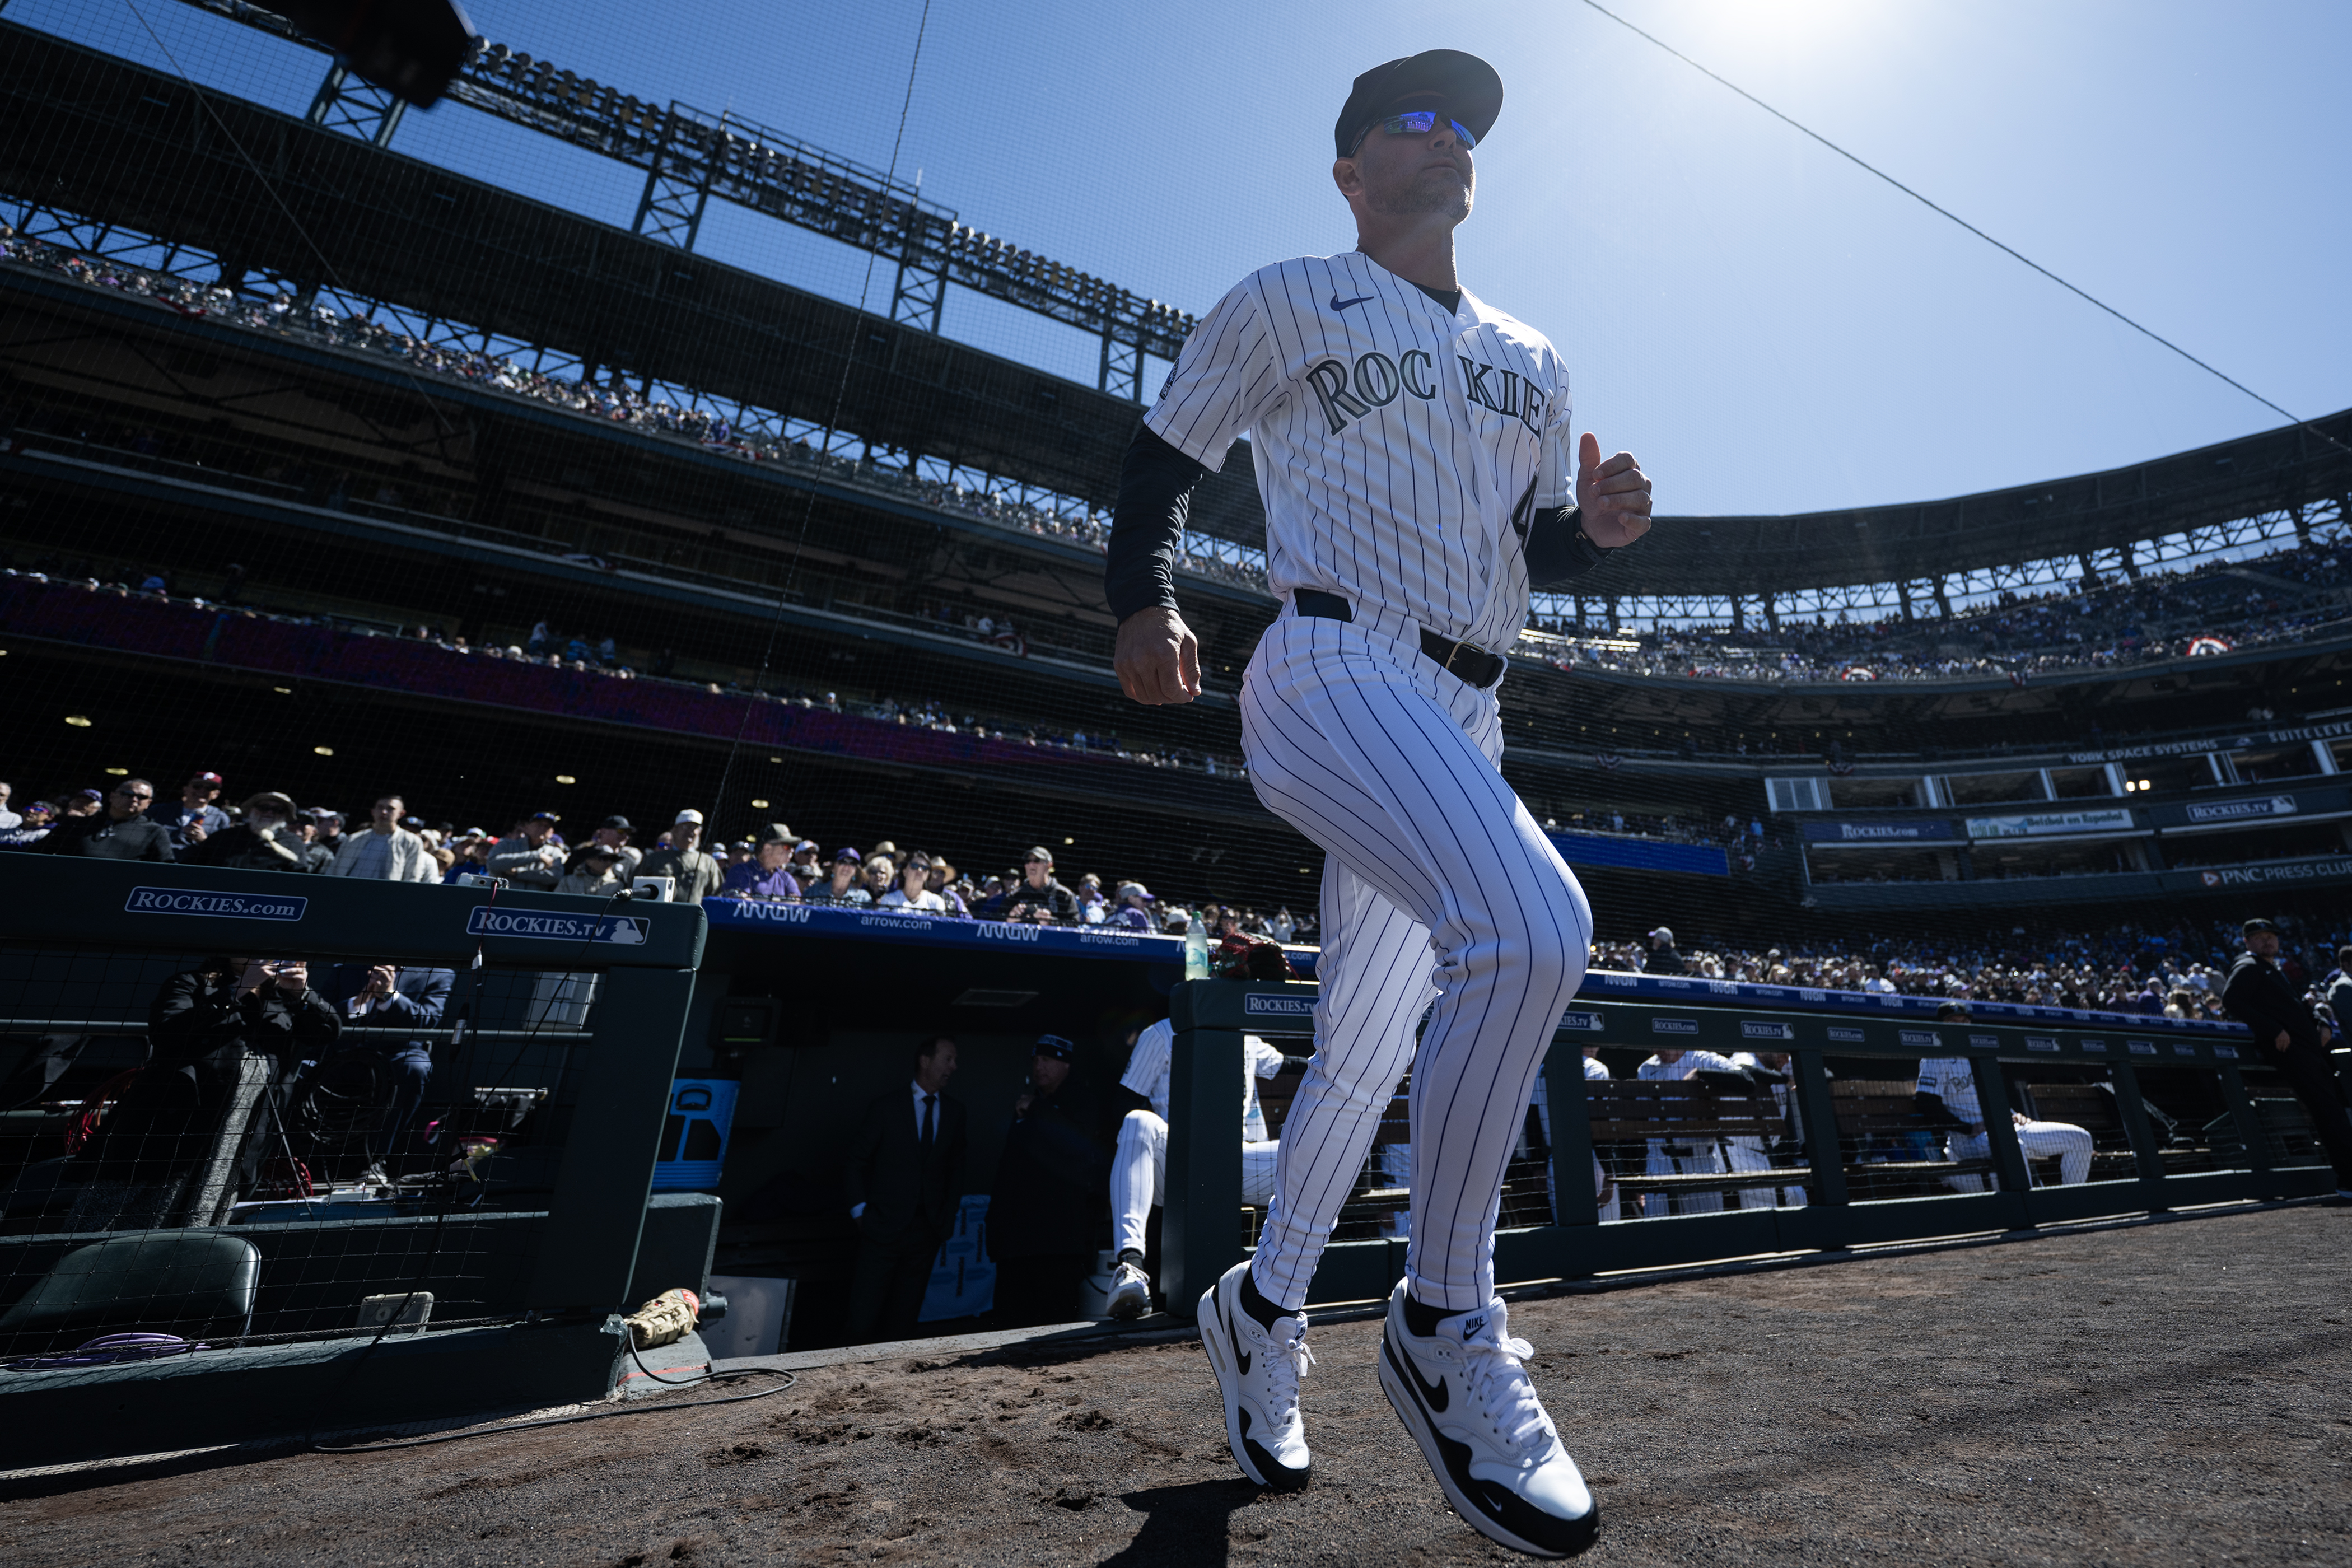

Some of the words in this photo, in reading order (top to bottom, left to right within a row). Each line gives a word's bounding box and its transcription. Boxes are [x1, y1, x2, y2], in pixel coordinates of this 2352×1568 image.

[2268, 727, 2312, 743] SUITE
[2313, 721, 2352, 738] LEVE
[2069, 752, 2106, 764] YORK
[2107, 746, 2152, 760] SPACE
[2154, 740, 2218, 755] SYSTEMS
[1840, 823, 1919, 839] ROCKIES.com
[2221, 867, 2264, 885] PNC
[2264, 864, 2314, 880] PRESS
[133, 892, 295, 916] ROCKIES.com
[475, 912, 606, 937] ROCKIES.TV
[860, 915, 933, 931] arrow.com
[1080, 934, 1140, 946] arrow.com
[1654, 1020, 1696, 1032] ROCKIES.com
[1466, 1315, 1484, 1331] NIKE
